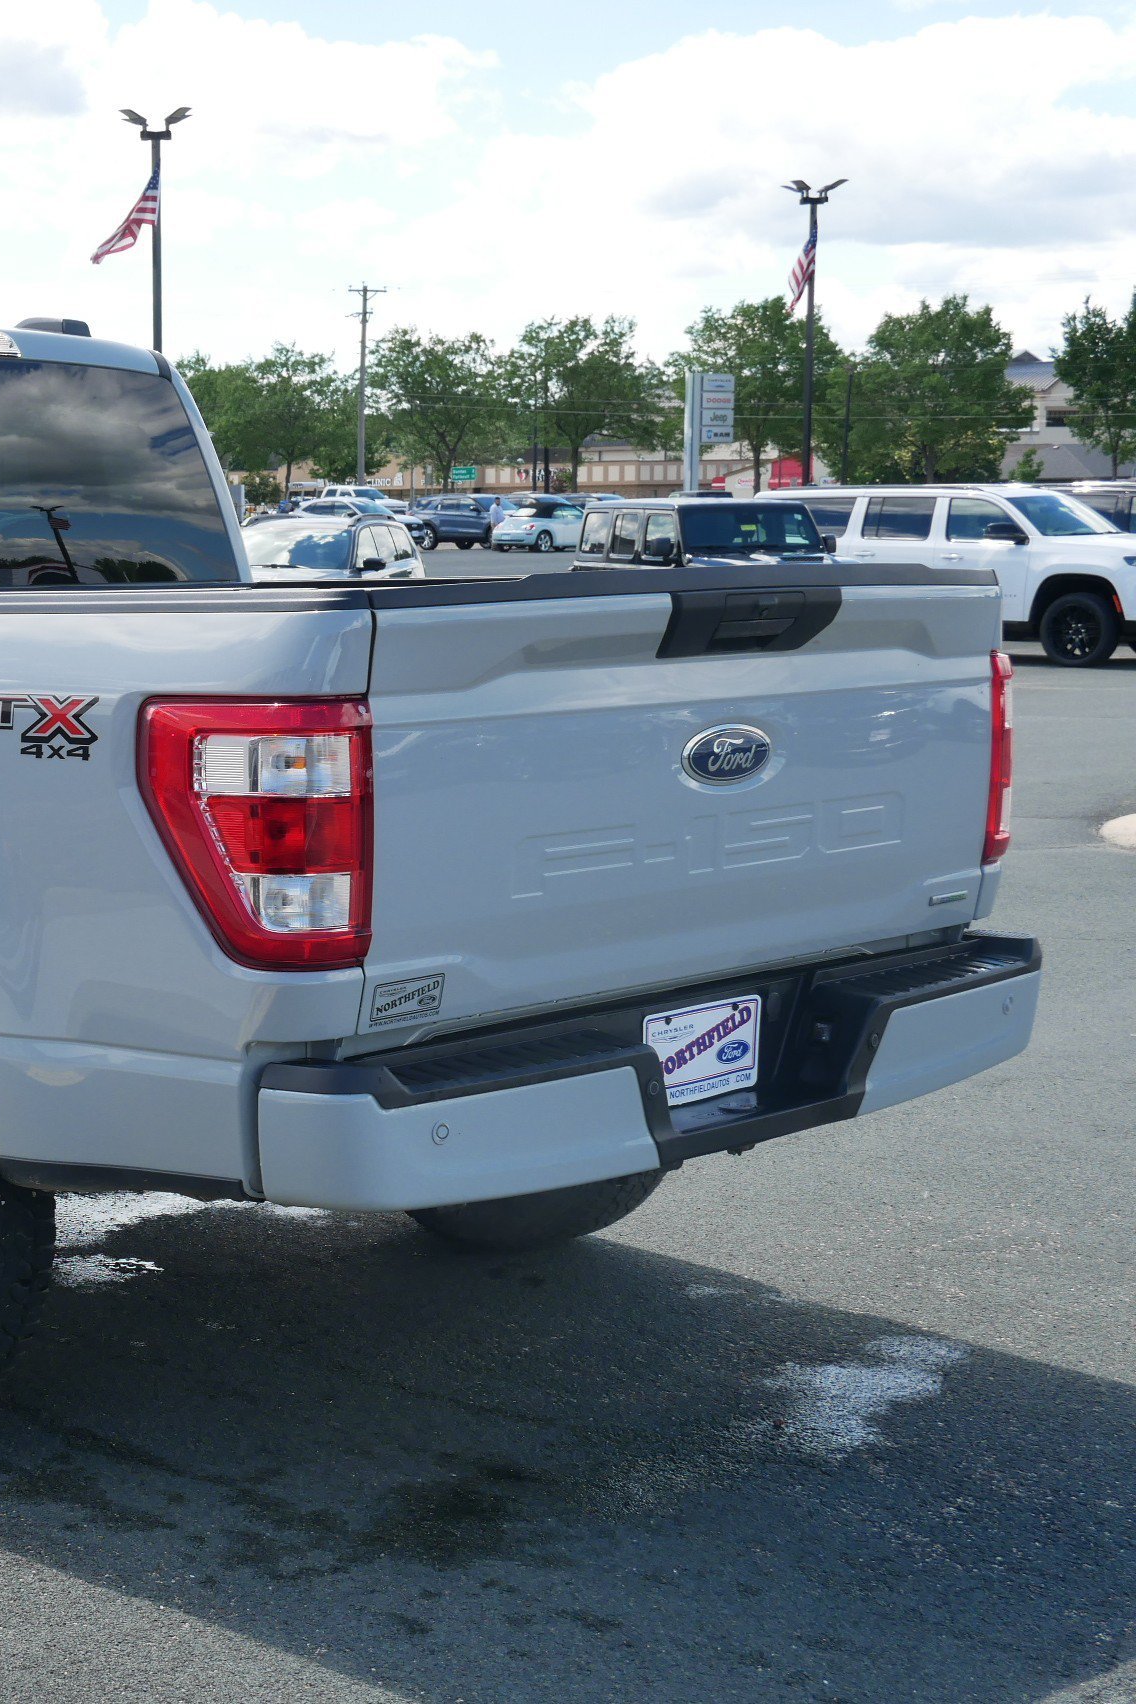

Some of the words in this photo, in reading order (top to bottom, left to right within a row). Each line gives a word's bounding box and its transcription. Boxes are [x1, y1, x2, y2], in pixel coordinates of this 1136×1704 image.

[709, 412, 728, 424] Jeep
[366, 478, 391, 487] CLINIC
[708, 738, 756, 772] Ford
[511, 790, 905, 898] F-150
[375, 979, 440, 1016] NORTHFIELD
[651, 1023, 695, 1038] CHRYSLER
[722, 1044, 743, 1060] Ford
